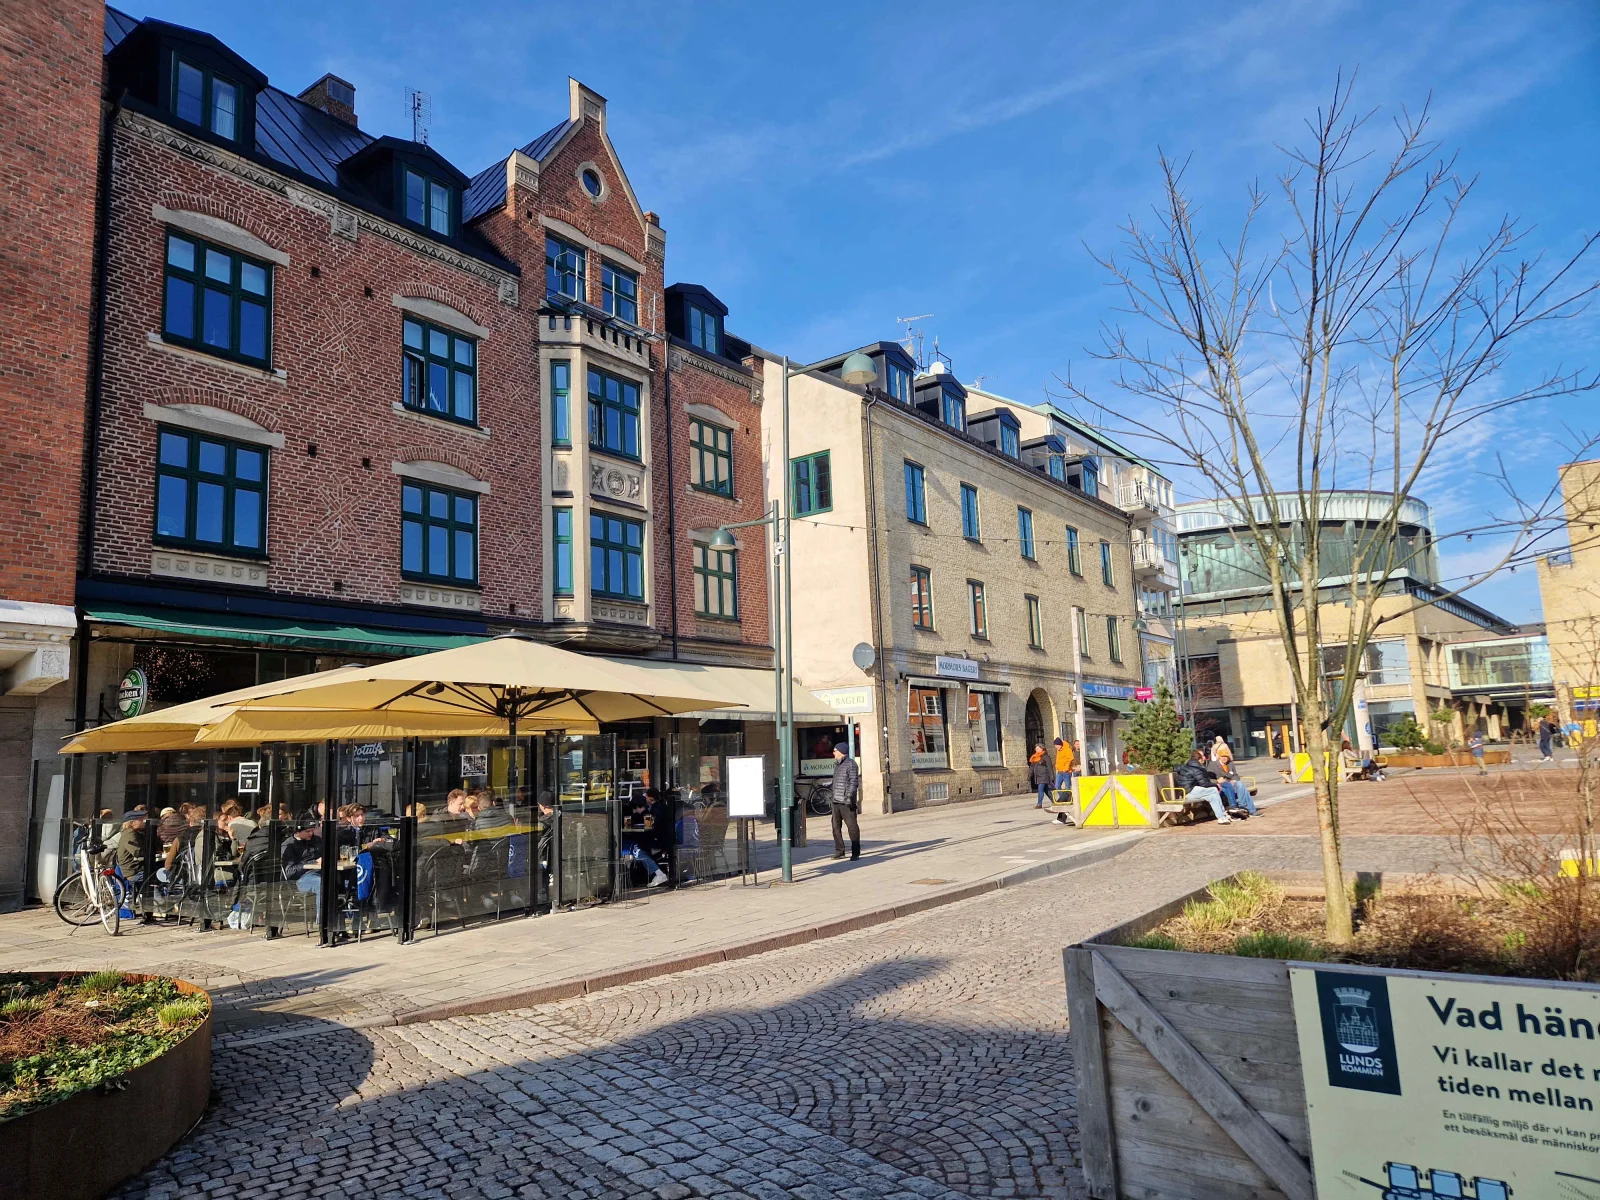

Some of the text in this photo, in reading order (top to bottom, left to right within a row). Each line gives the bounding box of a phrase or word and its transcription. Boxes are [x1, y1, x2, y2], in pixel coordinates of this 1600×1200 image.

[835, 695, 865, 705] BAGERI
[1426, 995, 1600, 1040] Vad hän
[1339, 1053, 1383, 1069] LUNDS
[1341, 1064, 1384, 1076] KOMMUN
[1432, 1045, 1458, 1065] Vi
[1465, 1048, 1534, 1073] kallar
[1541, 1058, 1585, 1080] det
[1438, 1075, 1593, 1112] tiden mellan
[1442, 1109, 1456, 1120] En
[1459, 1112, 1500, 1128] tillfällig
[1502, 1119, 1530, 1132] miljö
[1533, 1121, 1551, 1133] där
[1553, 1125, 1563, 1134] vi
[1566, 1127, 1586, 1139] kan
[1444, 1123, 1599, 1154] ett besöksmål där människor
